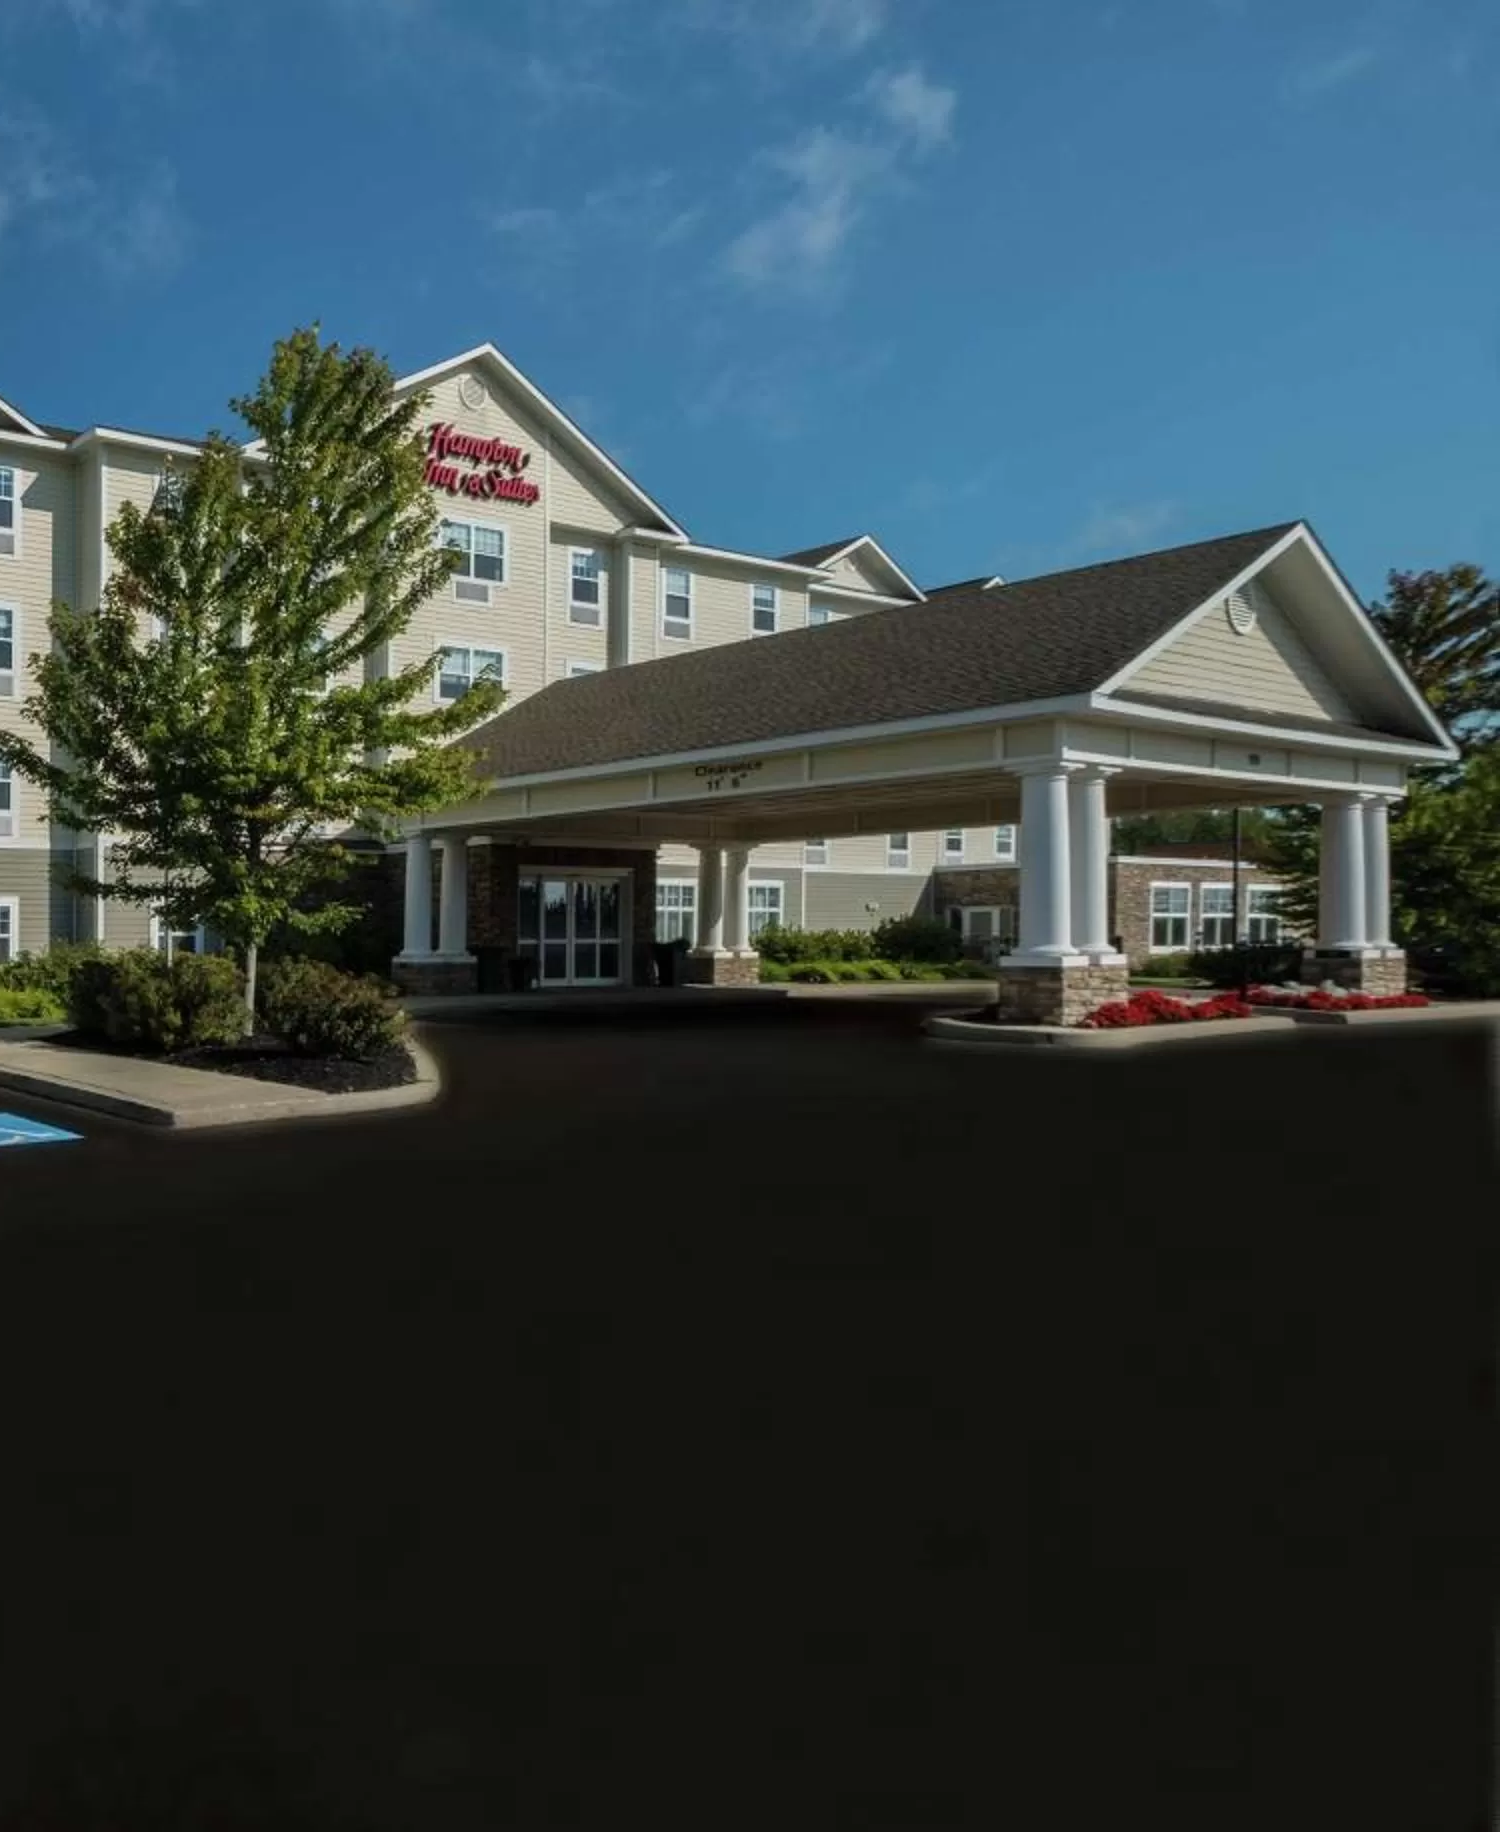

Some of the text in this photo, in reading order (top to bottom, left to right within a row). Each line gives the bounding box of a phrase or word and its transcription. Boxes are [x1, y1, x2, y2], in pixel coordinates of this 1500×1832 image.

[428, 422, 531, 473] Hampton
[422, 456, 468, 496] Inn
[479, 469, 540, 507] Suites
